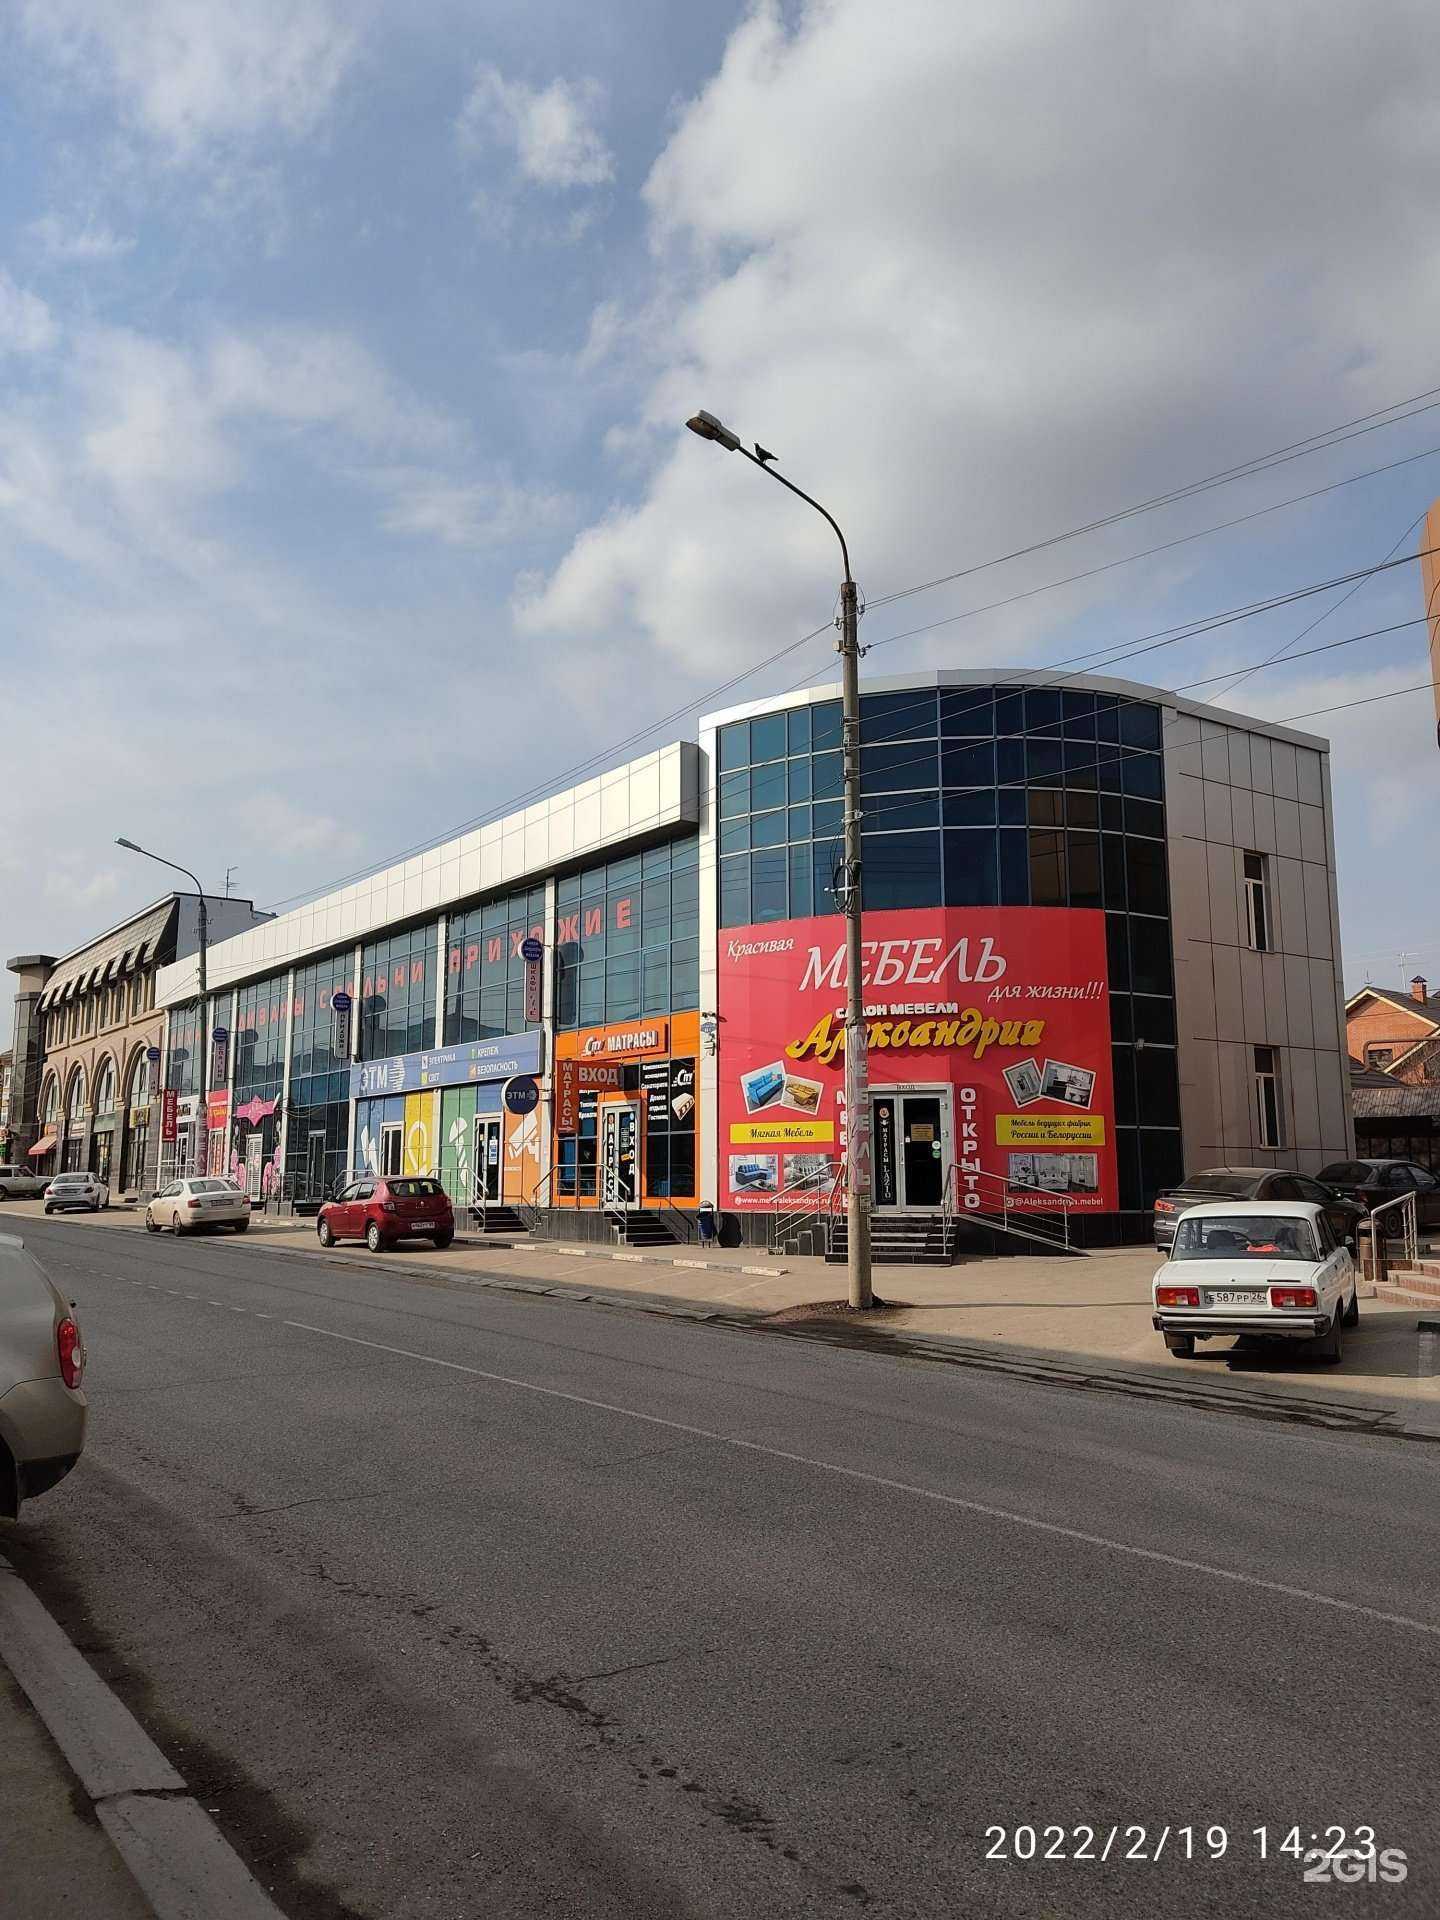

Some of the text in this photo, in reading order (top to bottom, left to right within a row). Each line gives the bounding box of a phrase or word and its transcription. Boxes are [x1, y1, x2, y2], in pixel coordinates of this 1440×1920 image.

[727, 938, 794, 963] Красивая
[319, 960, 424, 1010] САЛЬНИ
[987, 980, 1104, 1004] для жизни!!!
[890, 1001, 959, 1017] МЕБЕЛИ
[607, 1030, 658, 1052] МАТРАСЫ
[784, 1007, 1046, 1066] Алксандрия
[361, 1065, 388, 1091] ЭТМ
[562, 1062, 573, 1126] МАТРАСЫ
[579, 1067, 619, 1086] ВХОД
[166, 1091, 175, 1136] МЕБЕЛЬ
[506, 1091, 526, 1101] ЭТМ
[607, 1124, 616, 1202] МАТРАСЫ
[628, 1122, 636, 1176] ВХОД
[960, 1087, 981, 1209] ОТКРЫТО
